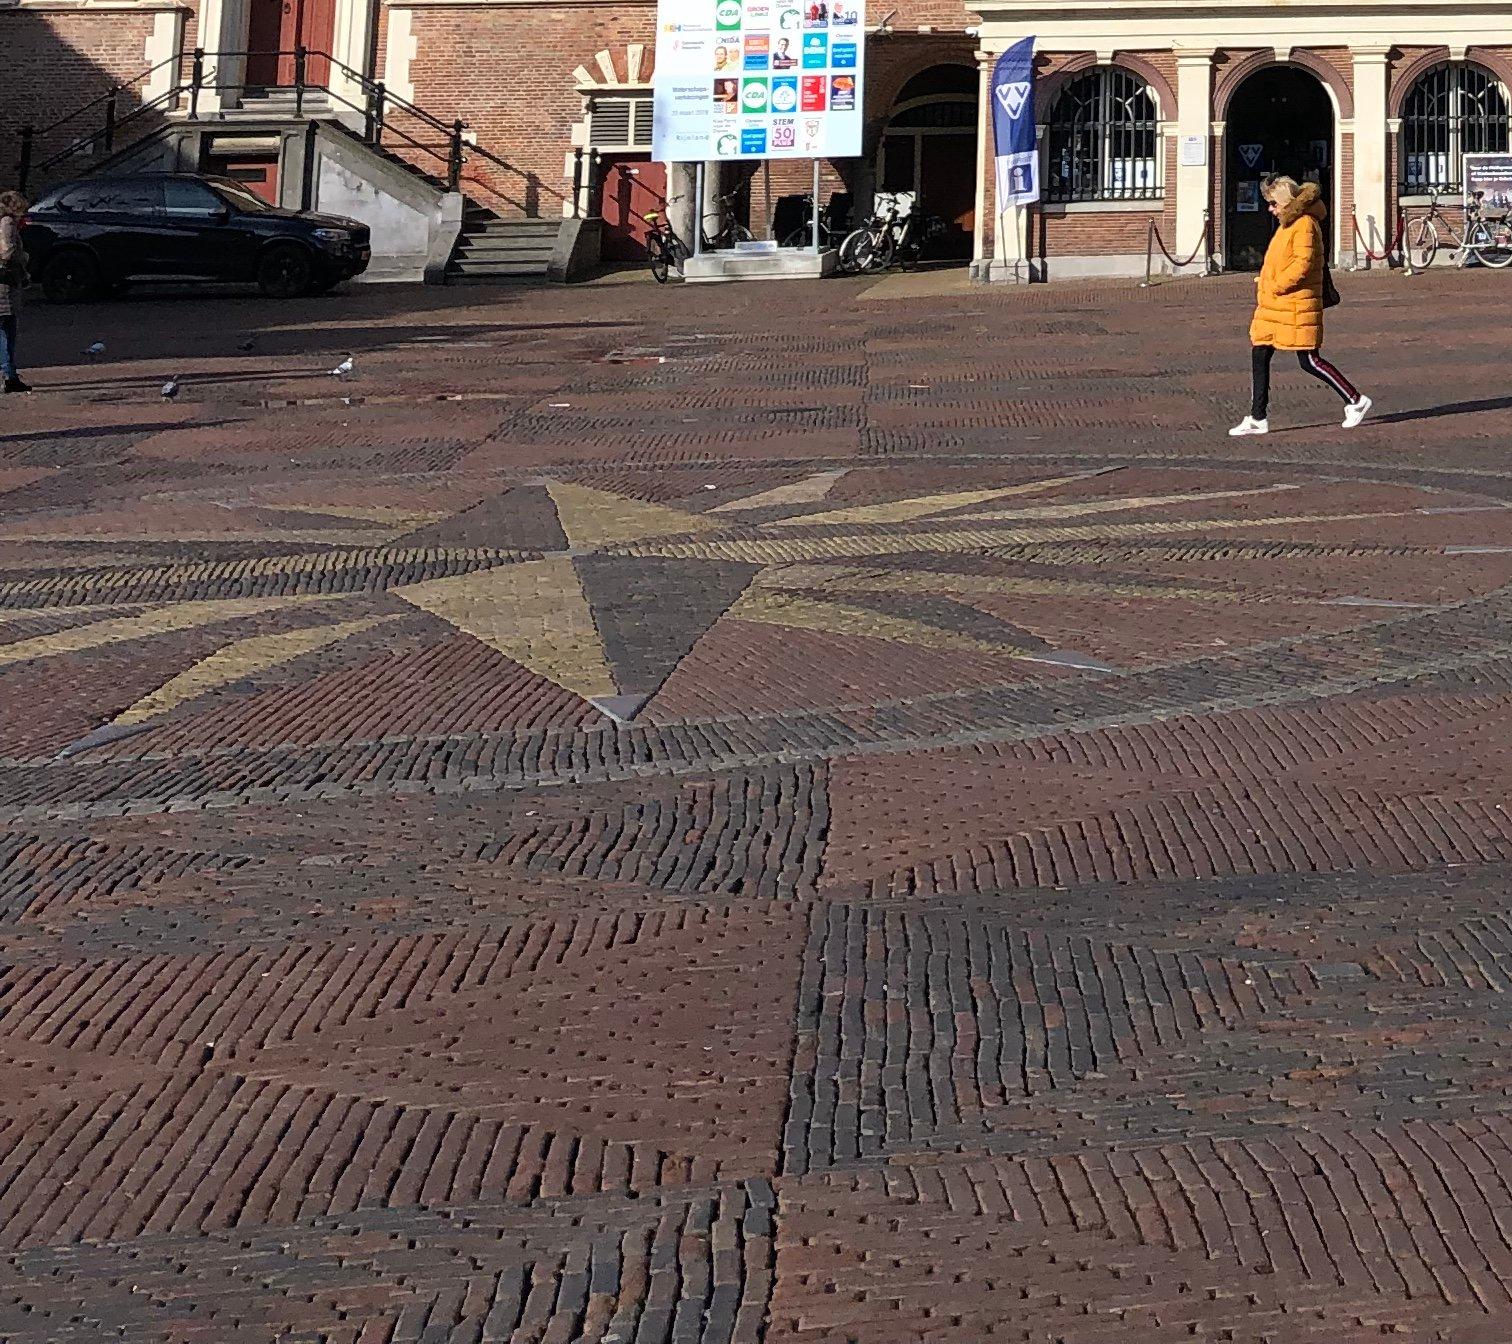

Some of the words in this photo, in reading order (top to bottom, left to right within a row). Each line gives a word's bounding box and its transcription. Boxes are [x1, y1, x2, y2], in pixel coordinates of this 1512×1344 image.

[719, 9, 739, 17] CDA
[773, 118, 794, 126] STEM
[774, 127, 792, 140] 50
